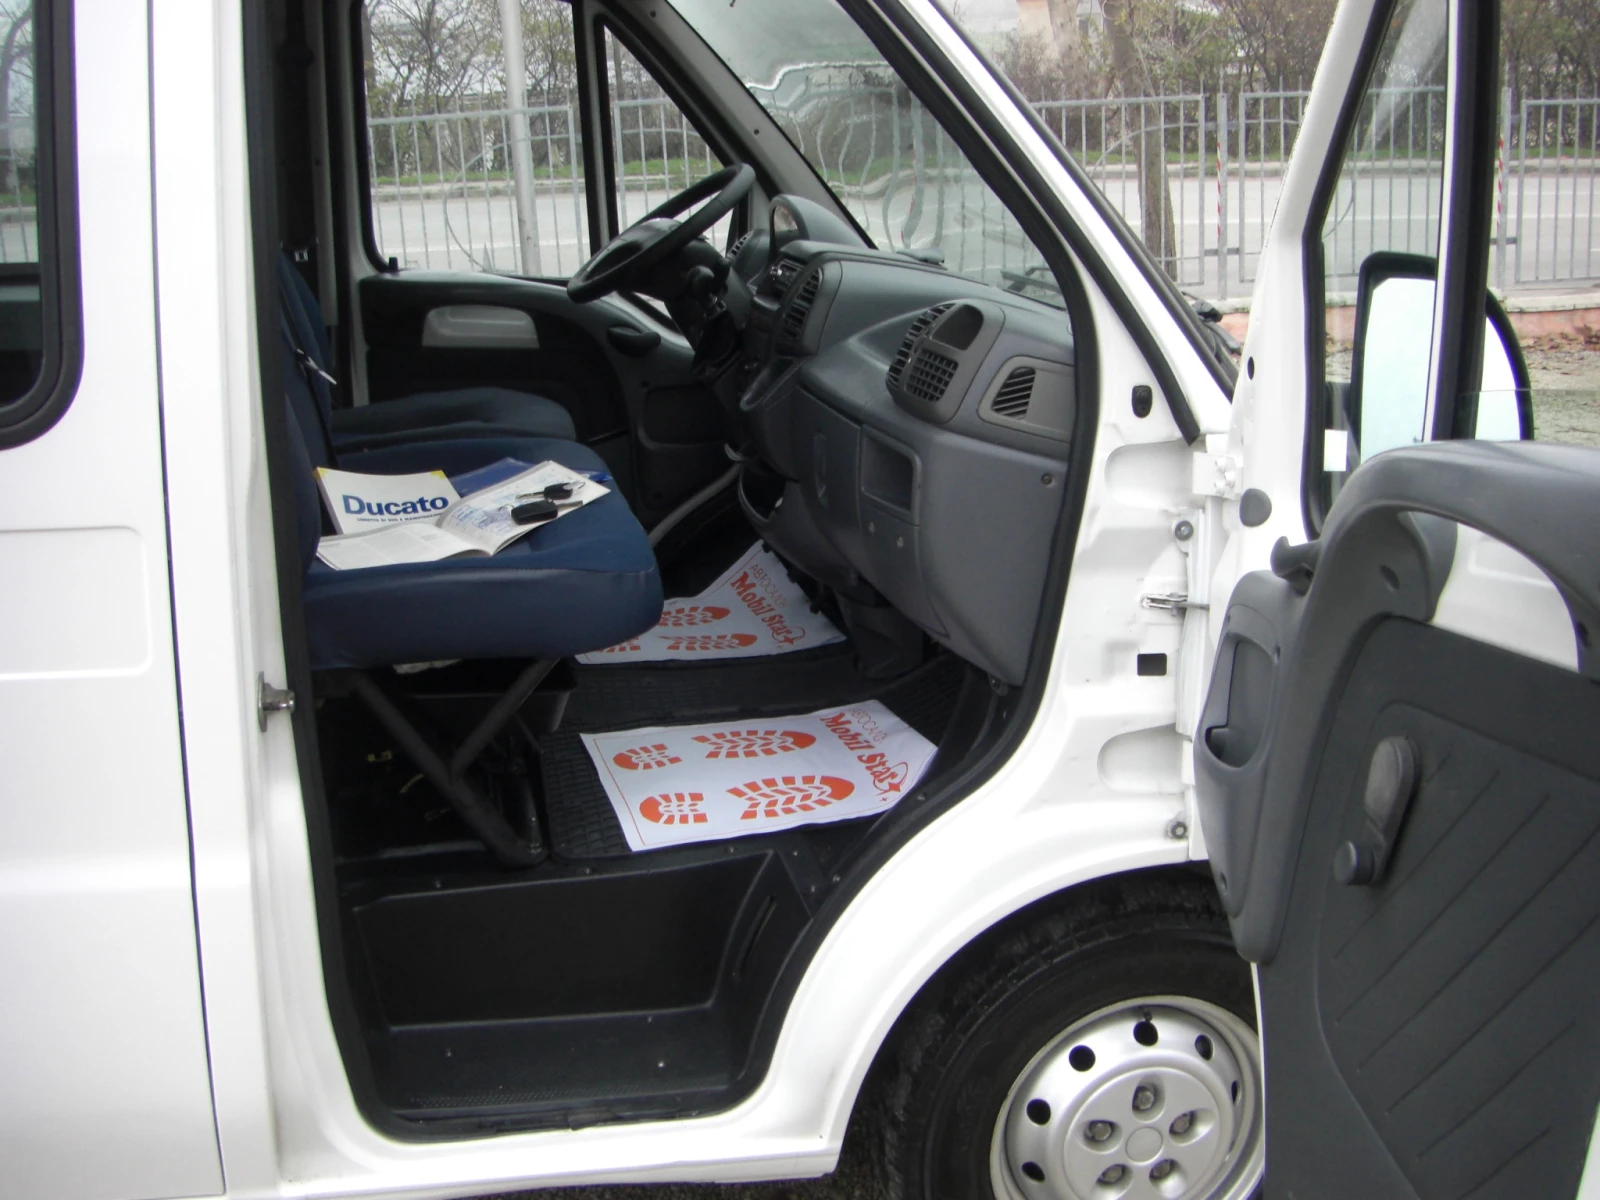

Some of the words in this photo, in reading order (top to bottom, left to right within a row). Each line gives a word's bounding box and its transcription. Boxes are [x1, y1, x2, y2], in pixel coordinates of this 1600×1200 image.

[342, 494, 449, 516] Ducato
[730, 571, 777, 616] Mobil
[761, 613, 793, 636] Star
[819, 712, 876, 751] Mobil
[857, 752, 898, 783] Star
